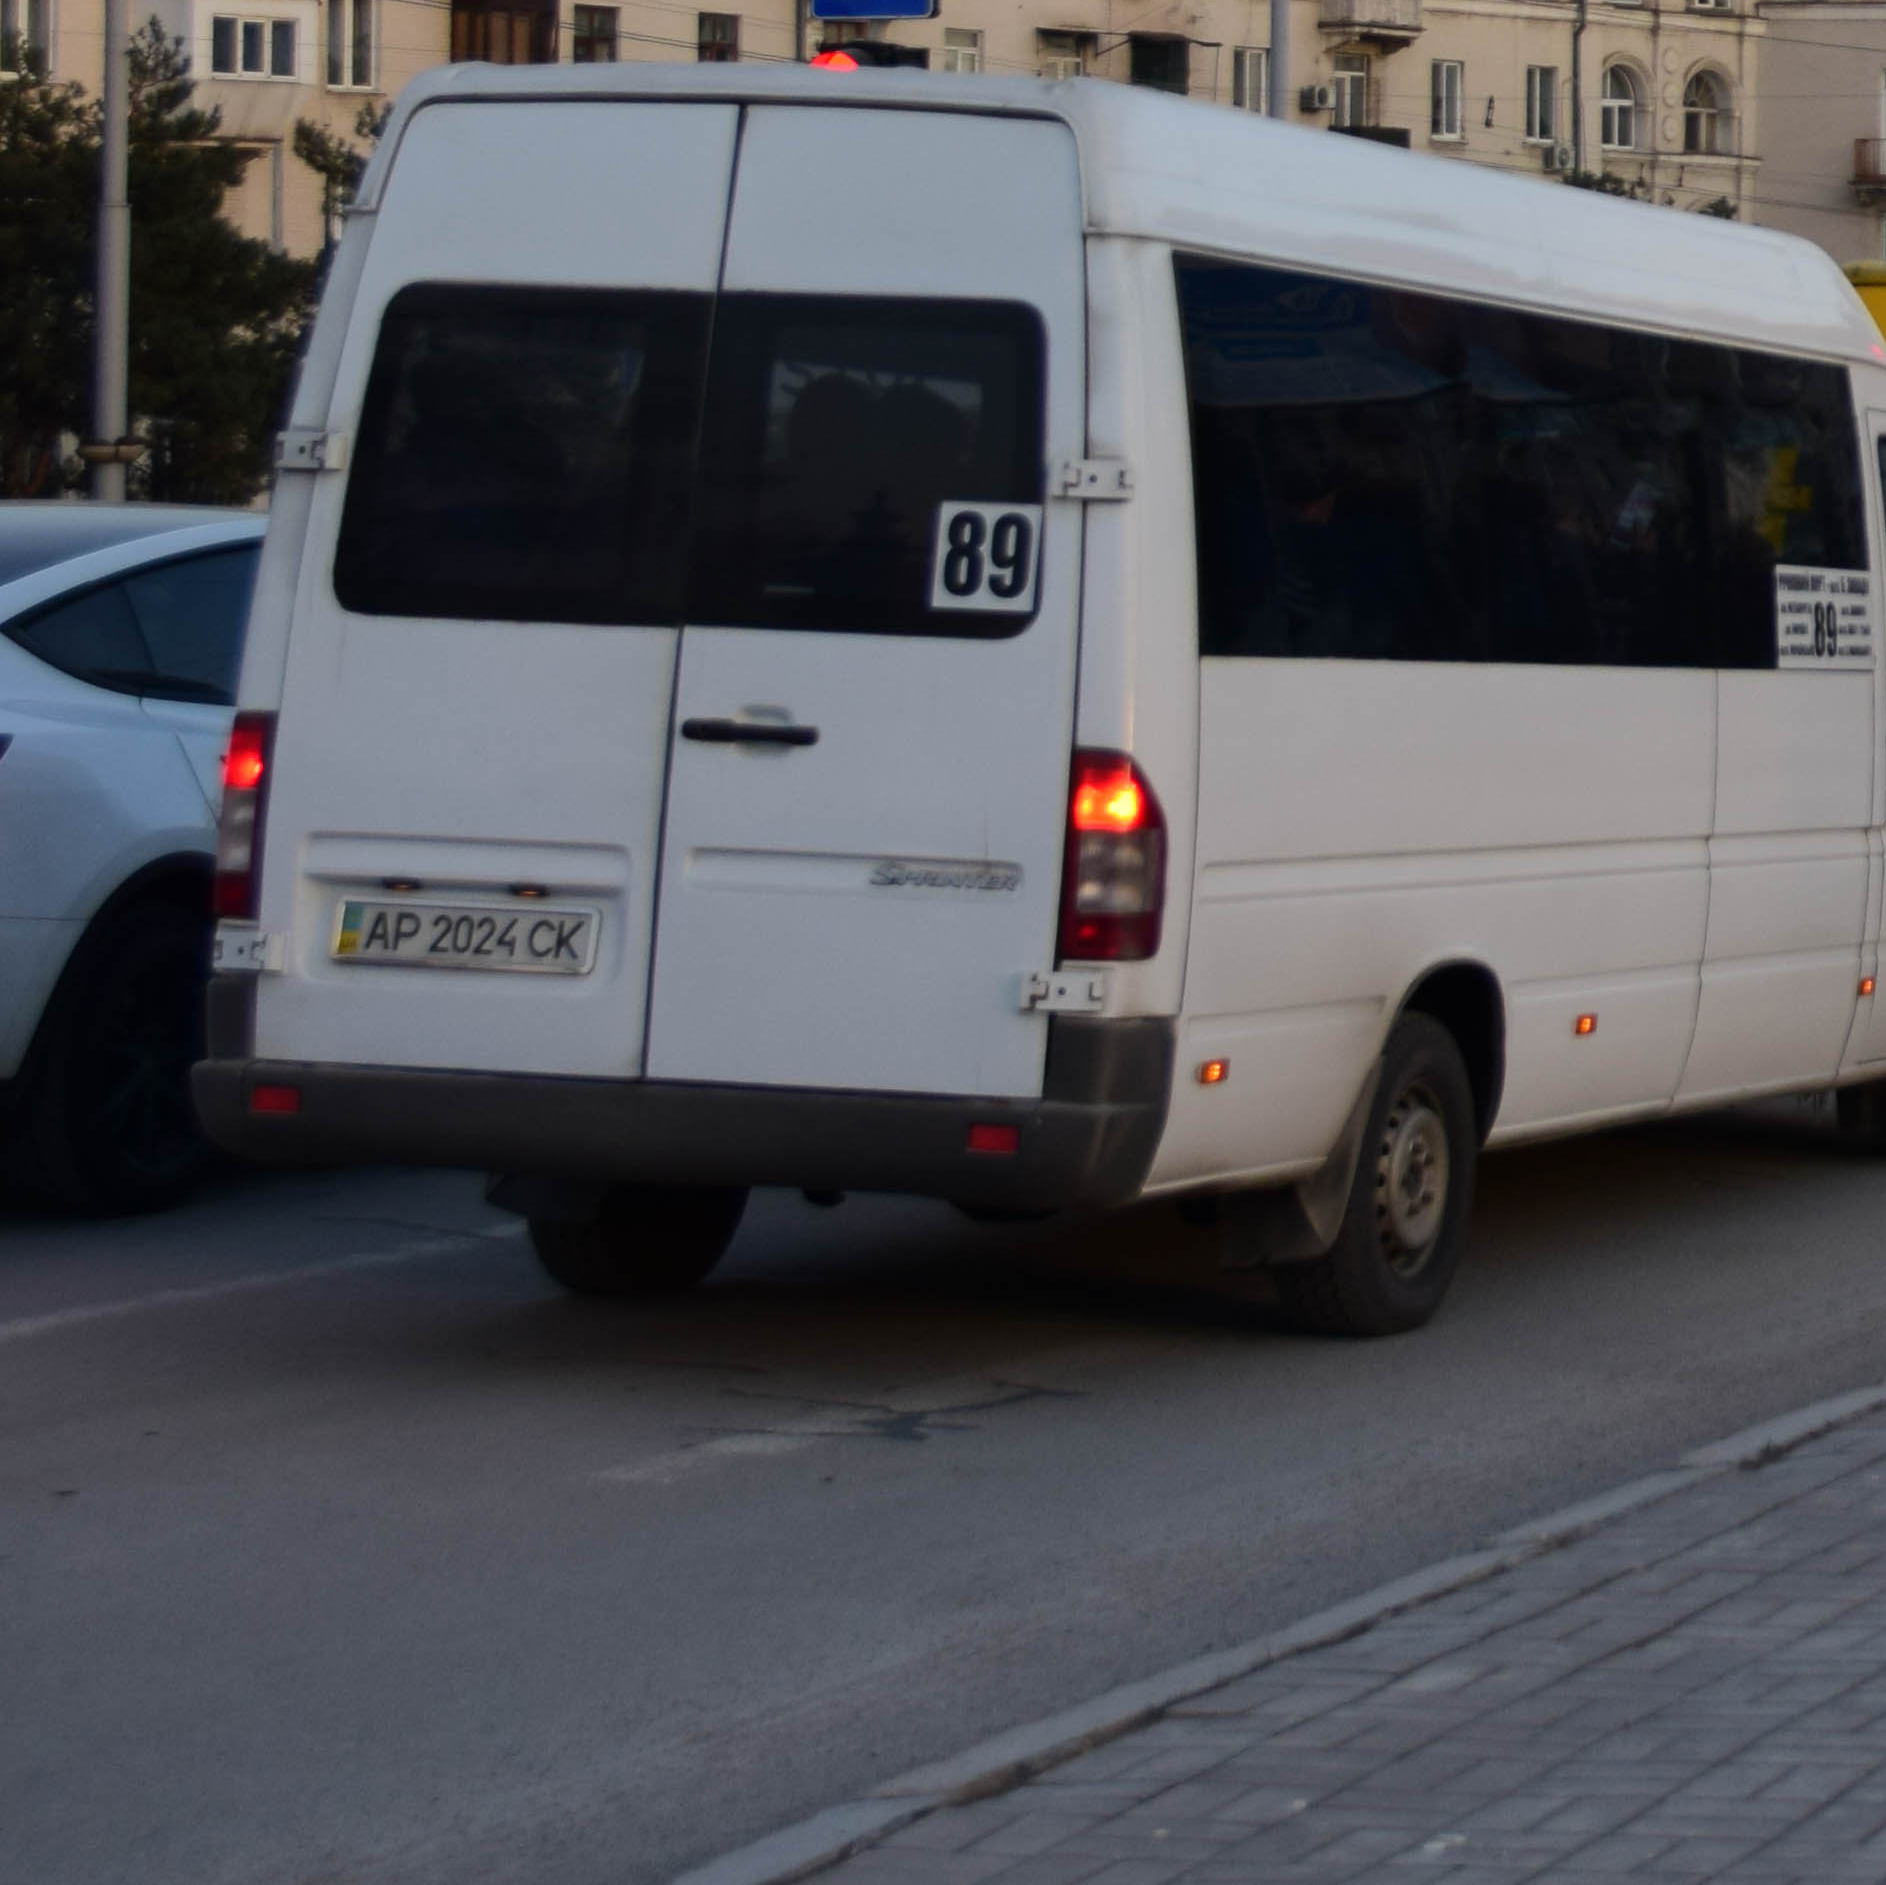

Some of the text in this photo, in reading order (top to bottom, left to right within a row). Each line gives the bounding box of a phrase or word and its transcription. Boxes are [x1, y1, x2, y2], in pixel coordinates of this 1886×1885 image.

[942, 510, 1033, 600] 89
[1814, 601, 1838, 658] 89
[365, 911, 584, 959] AP 2024 CK
